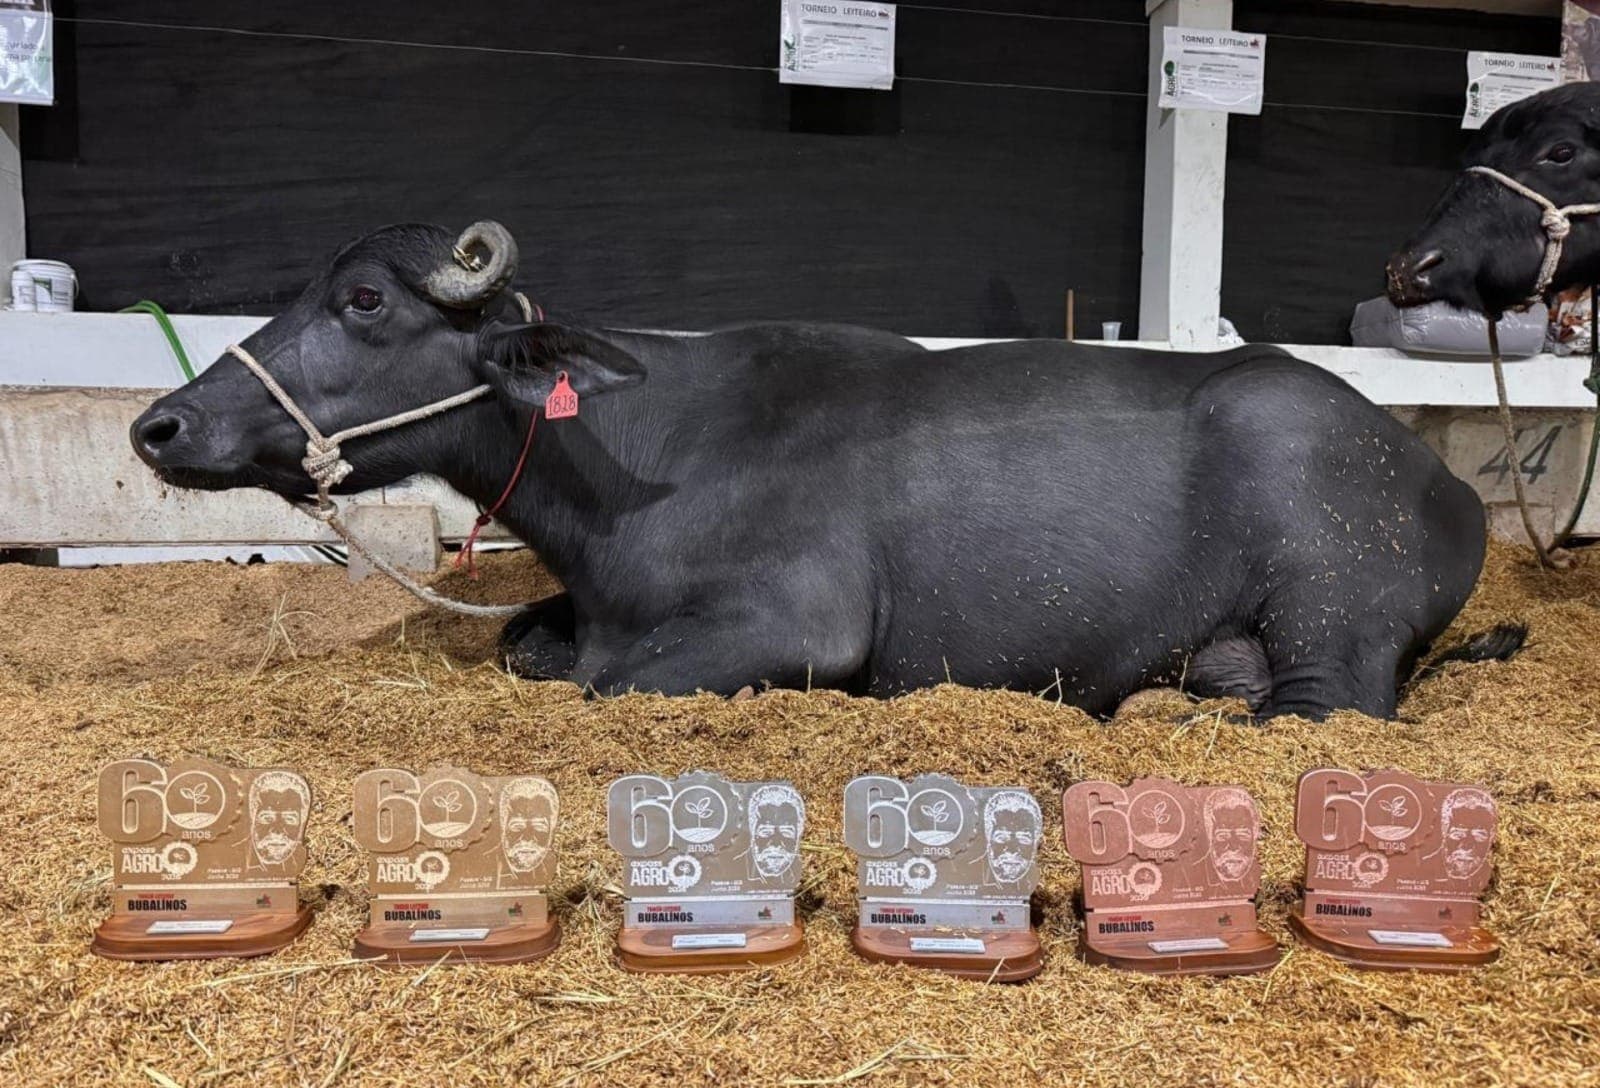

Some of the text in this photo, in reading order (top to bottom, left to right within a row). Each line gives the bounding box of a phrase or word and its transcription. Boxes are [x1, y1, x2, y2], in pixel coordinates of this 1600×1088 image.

[801, 4, 877, 18] TORNEIO LEITEIRO
[1182, 35, 1248, 47] TORNEIO LEITEIRO
[1485, 59, 1546, 70] TORNEIO LEITEIRO
[1477, 425, 1562, 485] 44
[182, 830, 211, 839] anos
[435, 839, 464, 848] anos
[688, 843, 714, 852] anos
[1378, 841, 1406, 851] anos
[923, 847, 950, 855] anos
[1147, 849, 1175, 857] anos
[122, 853, 163, 873] AGRO
[1315, 860, 1356, 879] AGRO
[377, 863, 416, 883] AGRO
[631, 867, 669, 886] AGRO
[866, 868, 905, 887] AGRO
[1091, 875, 1131, 896] AGRO
